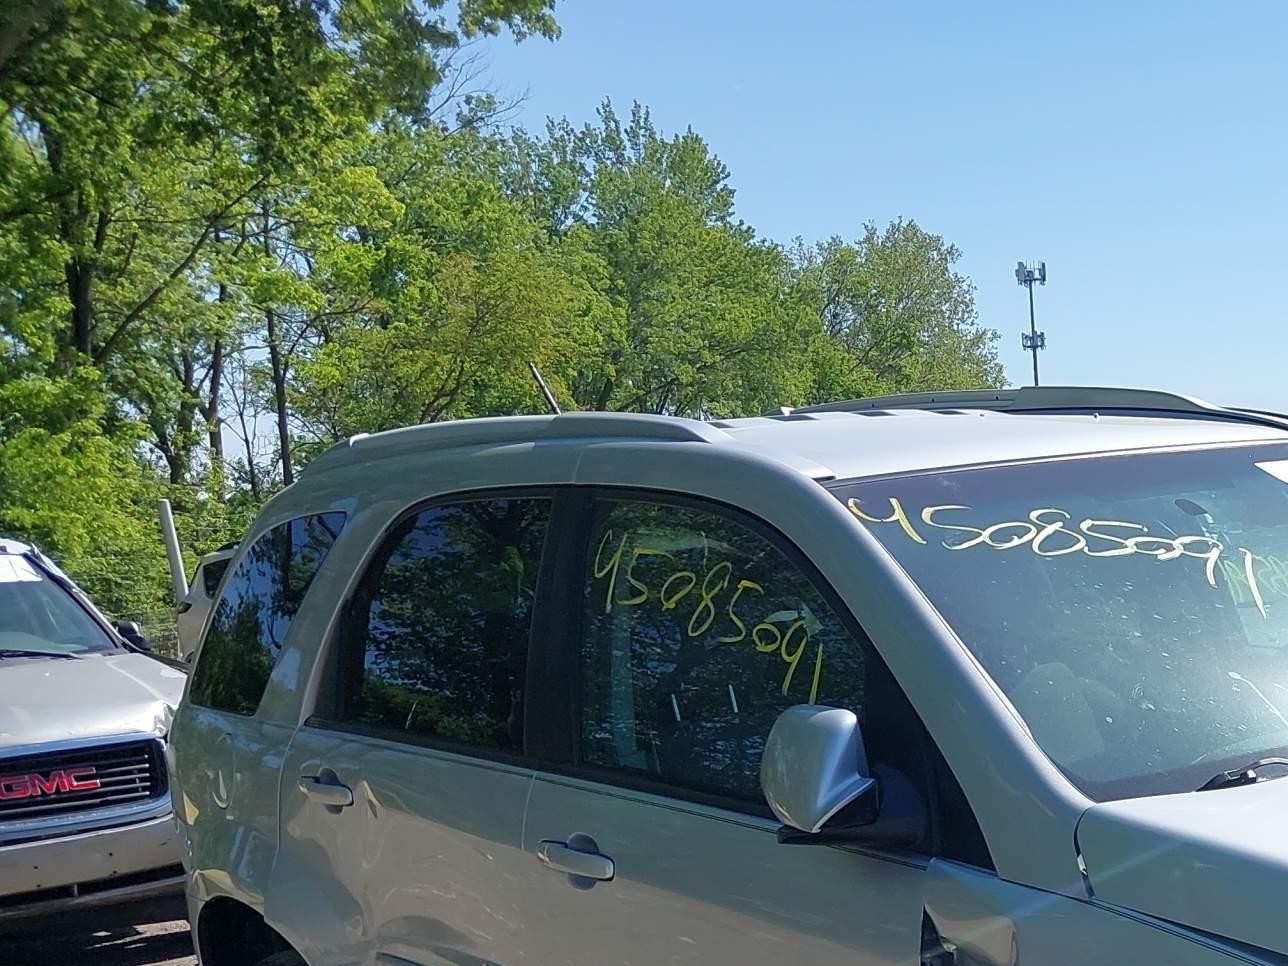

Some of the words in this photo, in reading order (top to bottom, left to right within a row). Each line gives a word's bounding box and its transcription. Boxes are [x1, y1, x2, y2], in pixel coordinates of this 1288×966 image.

[594, 529, 824, 705] 45085091
[847, 497, 1268, 620] 45085091
[0, 766, 101, 799] GMC
